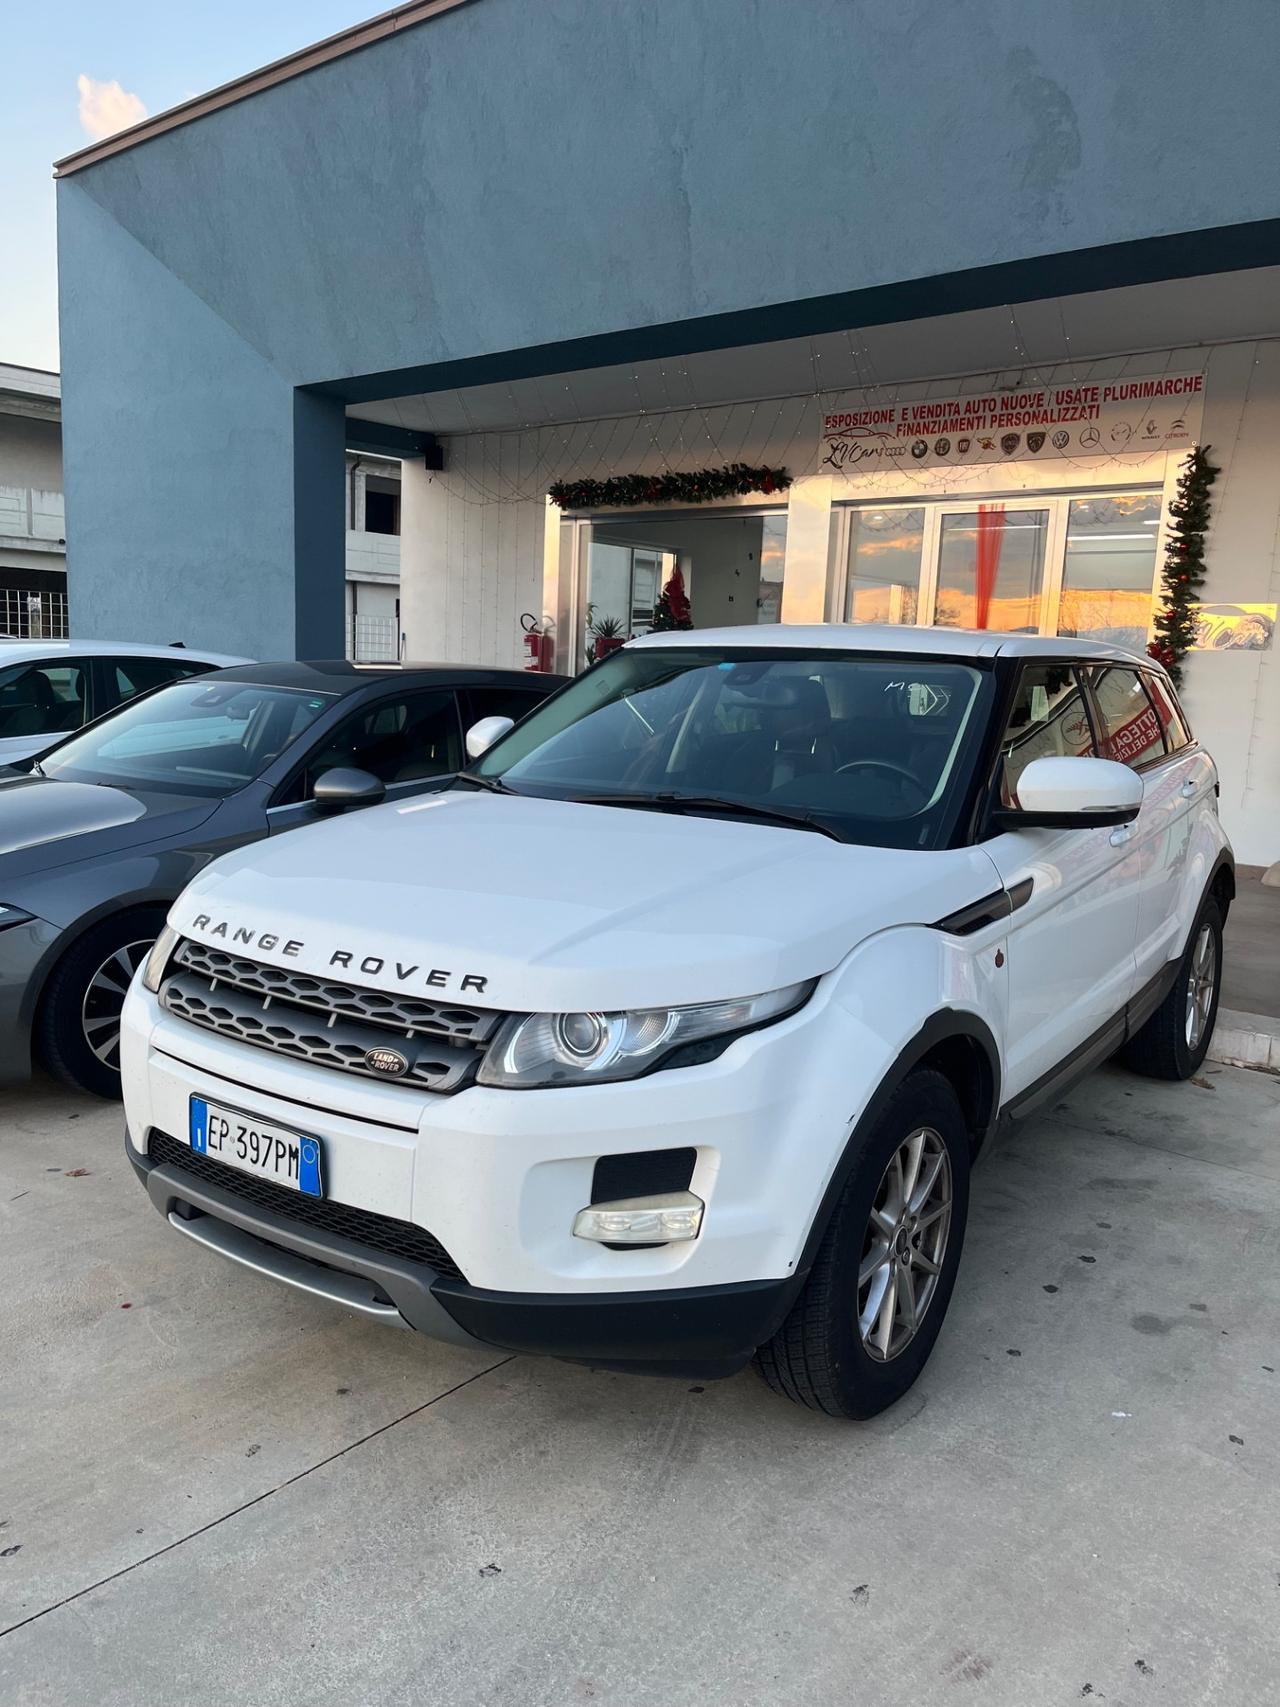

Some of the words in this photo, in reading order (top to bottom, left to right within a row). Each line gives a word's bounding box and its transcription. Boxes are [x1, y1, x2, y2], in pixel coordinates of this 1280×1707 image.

[825, 409, 896, 429] ESPOSIZIONE
[901, 407, 909, 421] E
[912, 402, 961, 420] VENDITA
[964, 398, 997, 416] AUTO
[1000, 392, 1045, 412] NUOVE
[1055, 386, 1100, 406] USATE
[1103, 376, 1203, 402] PLURIMARCHE
[896, 415, 986, 437] FINANZIAMENTI
[990, 404, 1100, 429] PERSONALIZZATI
[192, 914, 305, 957] RANGE
[329, 950, 488, 993] ROVER
[373, 1053, 394, 1063] LAND
[374, 1060, 400, 1072] ROVER
